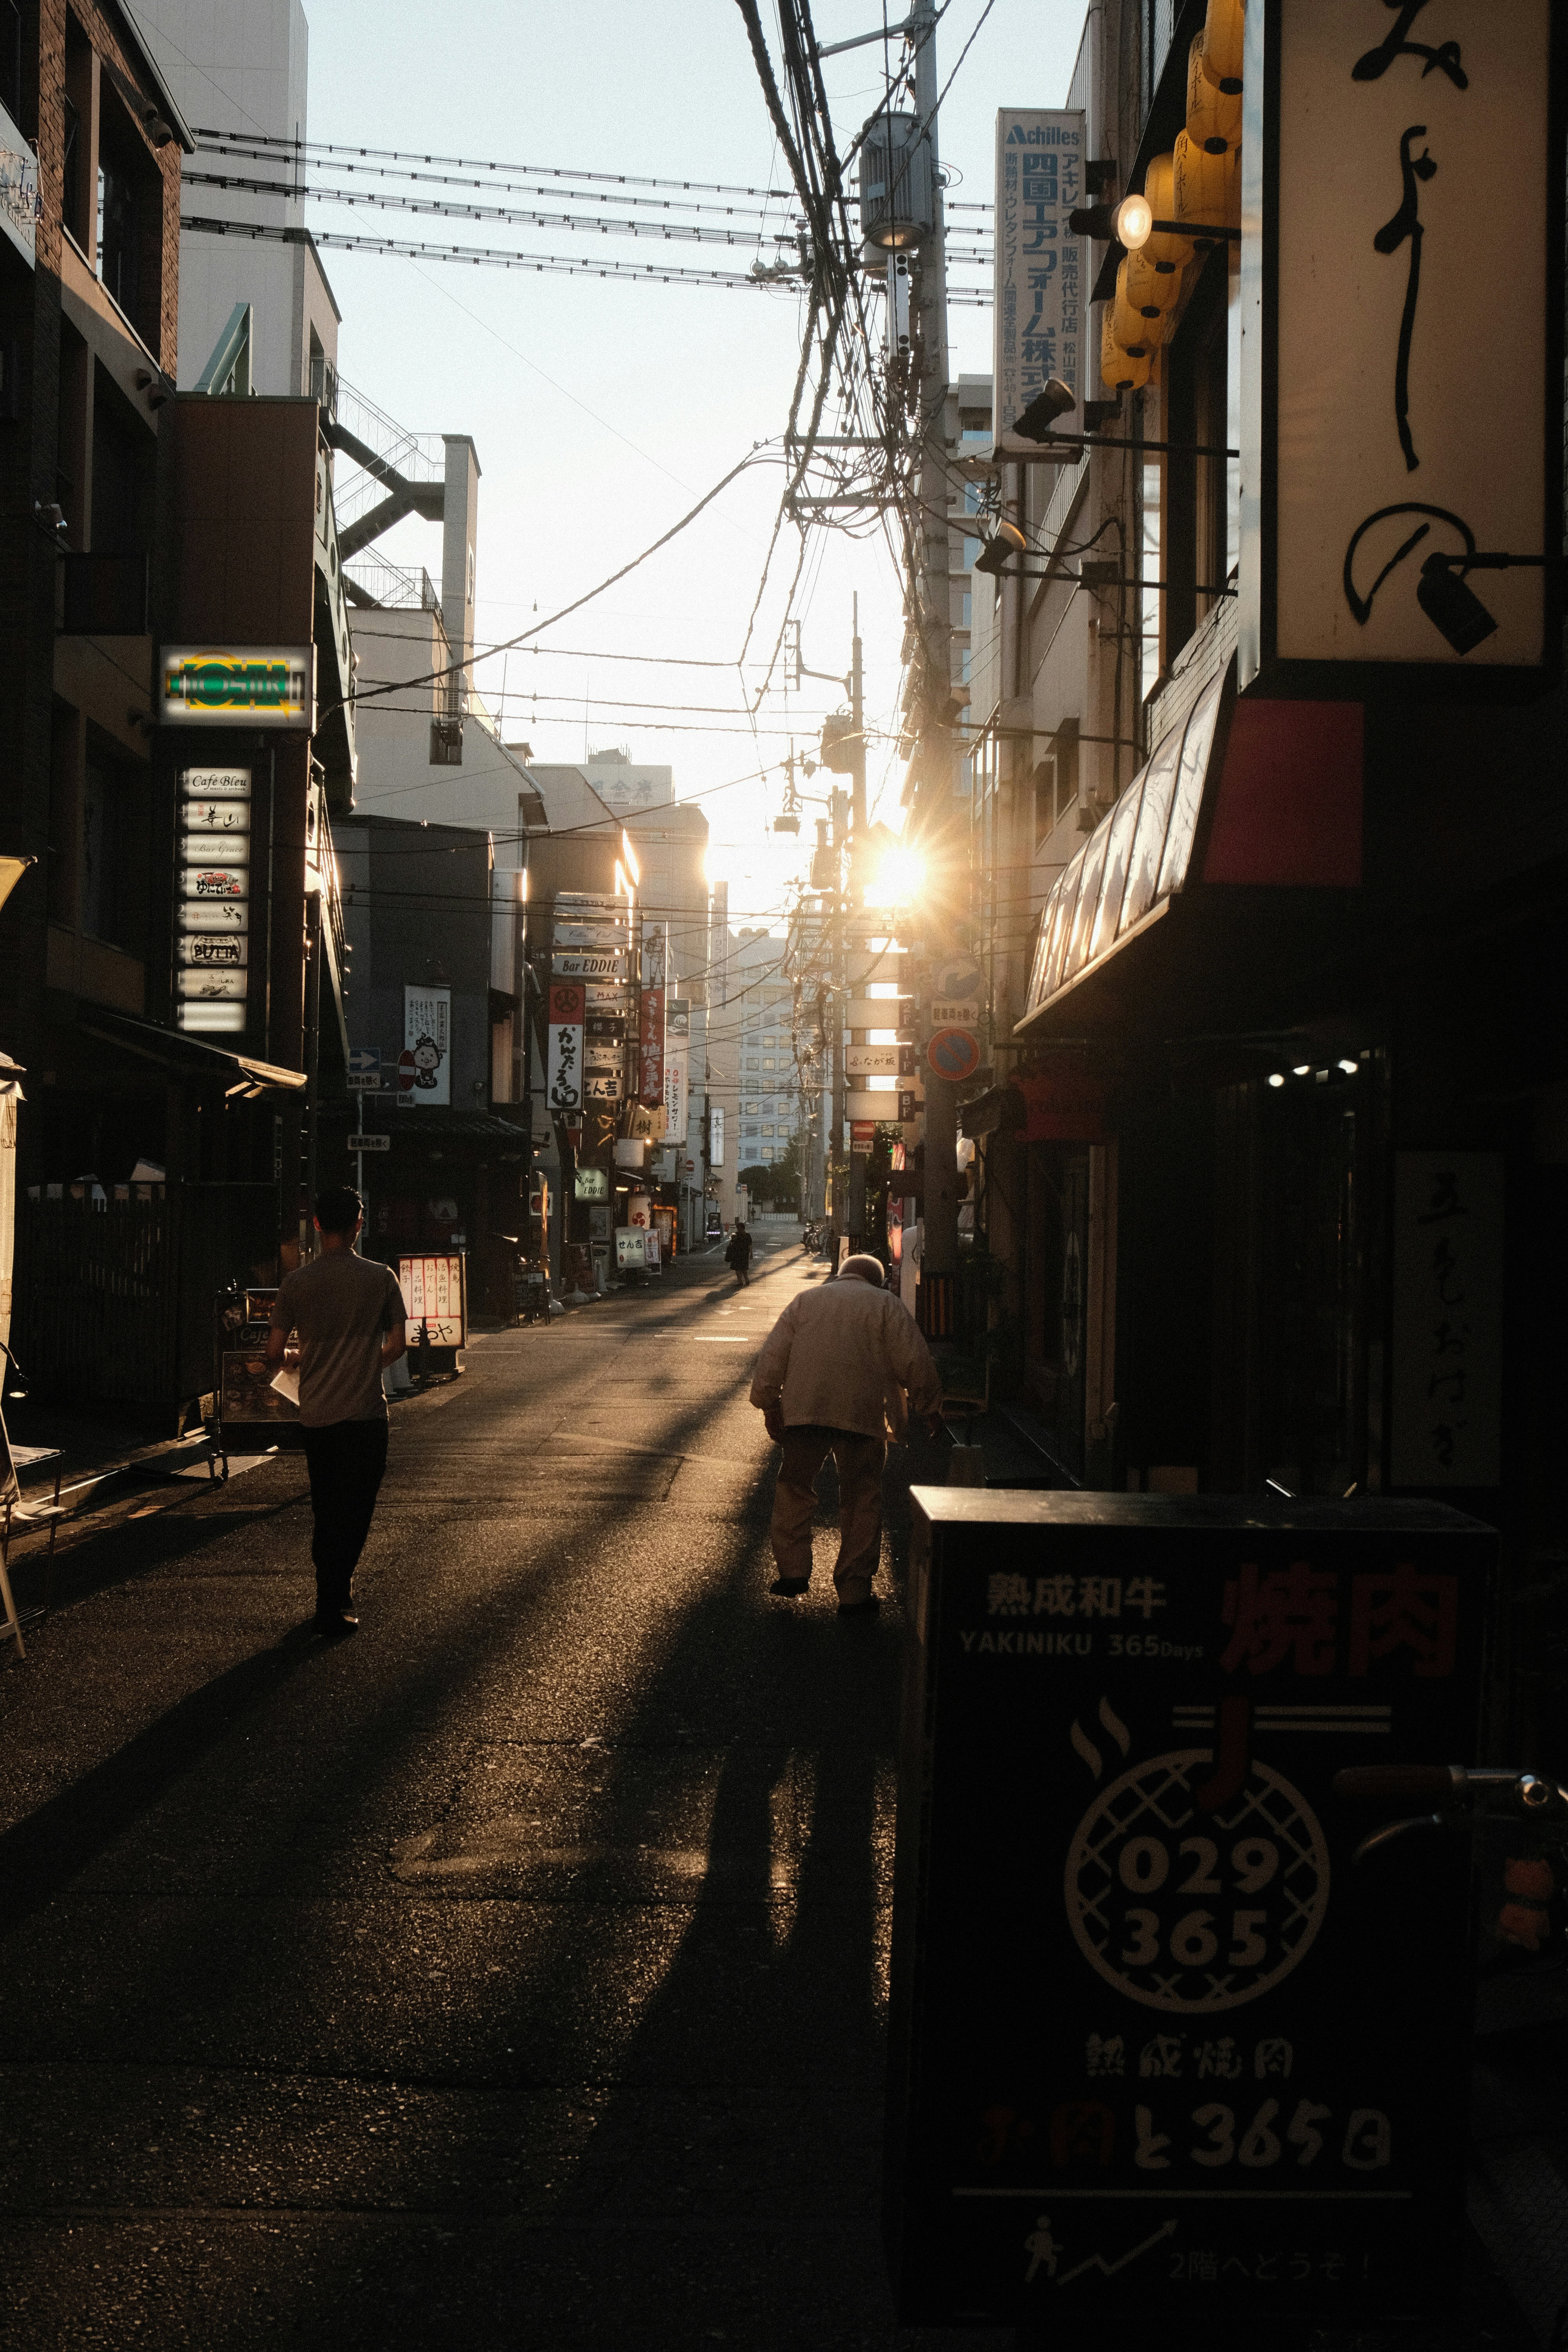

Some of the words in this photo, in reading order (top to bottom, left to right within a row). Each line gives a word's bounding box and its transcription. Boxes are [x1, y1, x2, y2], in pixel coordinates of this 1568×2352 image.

[1006, 125, 1080, 146] Achilles
[1021, 153, 1058, 431] 四国エアフォーム株式
[192, 774, 218, 790] Café
[220, 776, 247, 786] Bleu
[194, 944, 238, 959] BUTTA
[563, 960, 580, 972] Bar
[583, 959, 619, 973] EDDIE
[597, 992, 618, 1002] MAX
[584, 1187, 605, 1195] EDDIE
[985, 1573, 1168, 1619] 熟成和牛
[1220, 1562, 1461, 1679] 焼肉
[959, 1632, 1093, 1657] YAKINIKU
[1117, 1836, 1281, 1894] 029
[1121, 1910, 1270, 1965] 365
